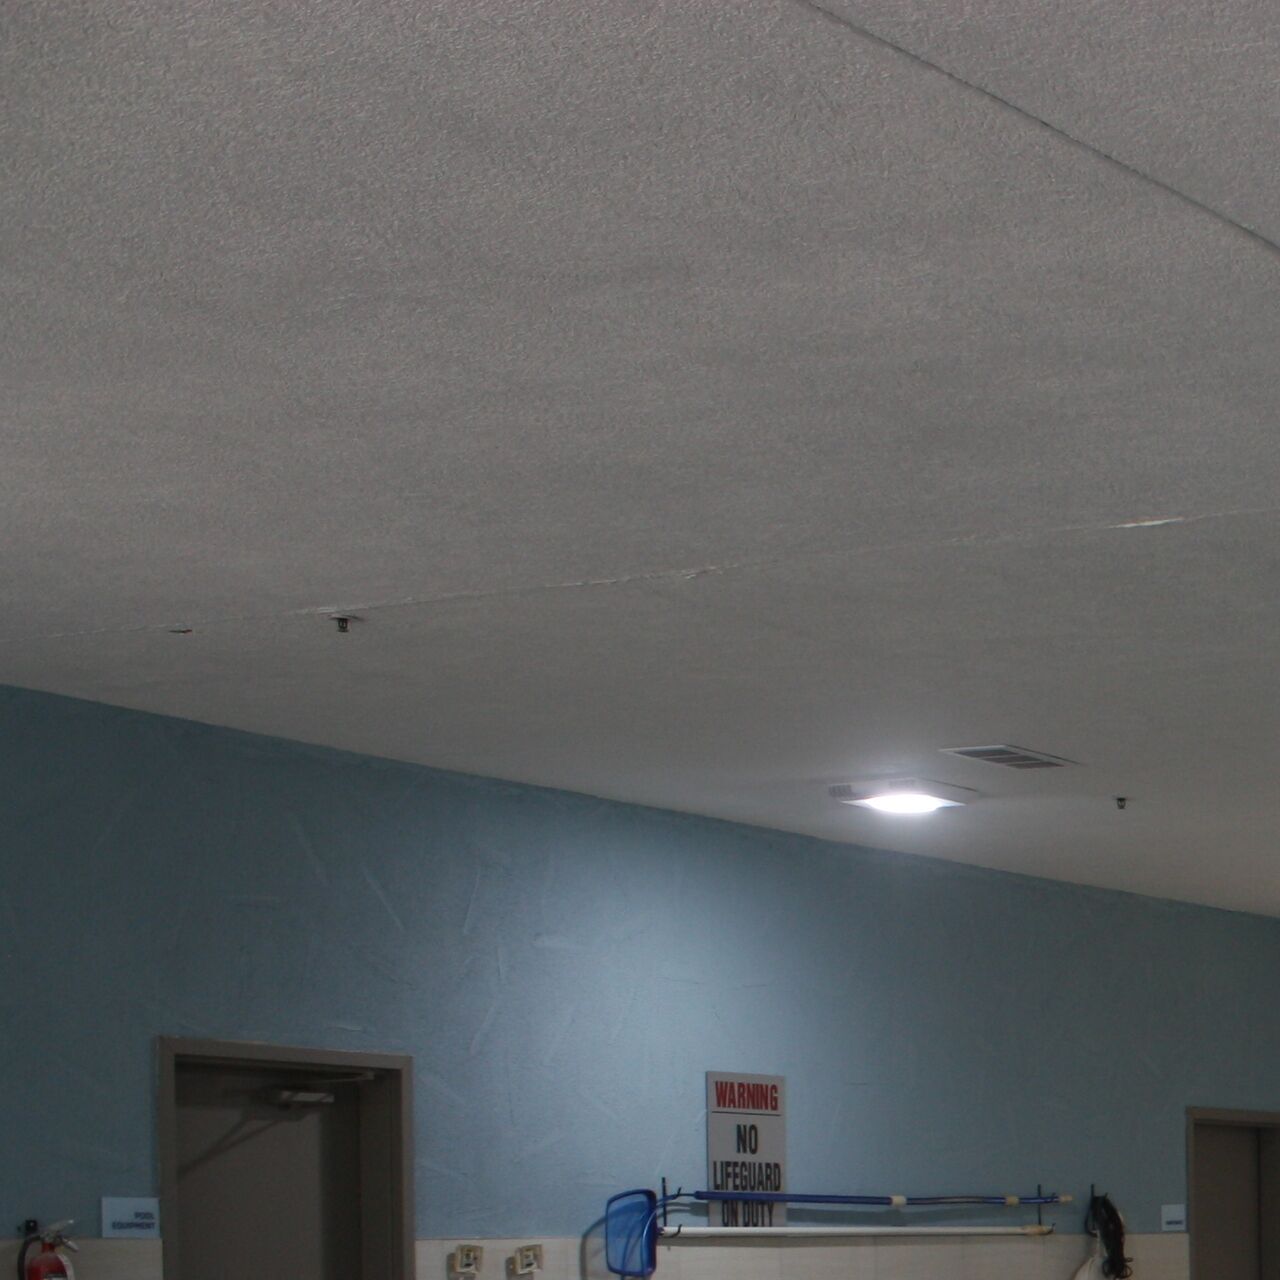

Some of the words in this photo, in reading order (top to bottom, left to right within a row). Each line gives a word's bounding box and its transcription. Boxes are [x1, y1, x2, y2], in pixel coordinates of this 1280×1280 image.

[715, 1080, 779, 1111] WARNING
[736, 1123, 758, 1155] NO
[713, 1161, 781, 1191] LIFEGUARD
[722, 1200, 738, 1227] ON
[742, 1200, 774, 1227] DUTY
